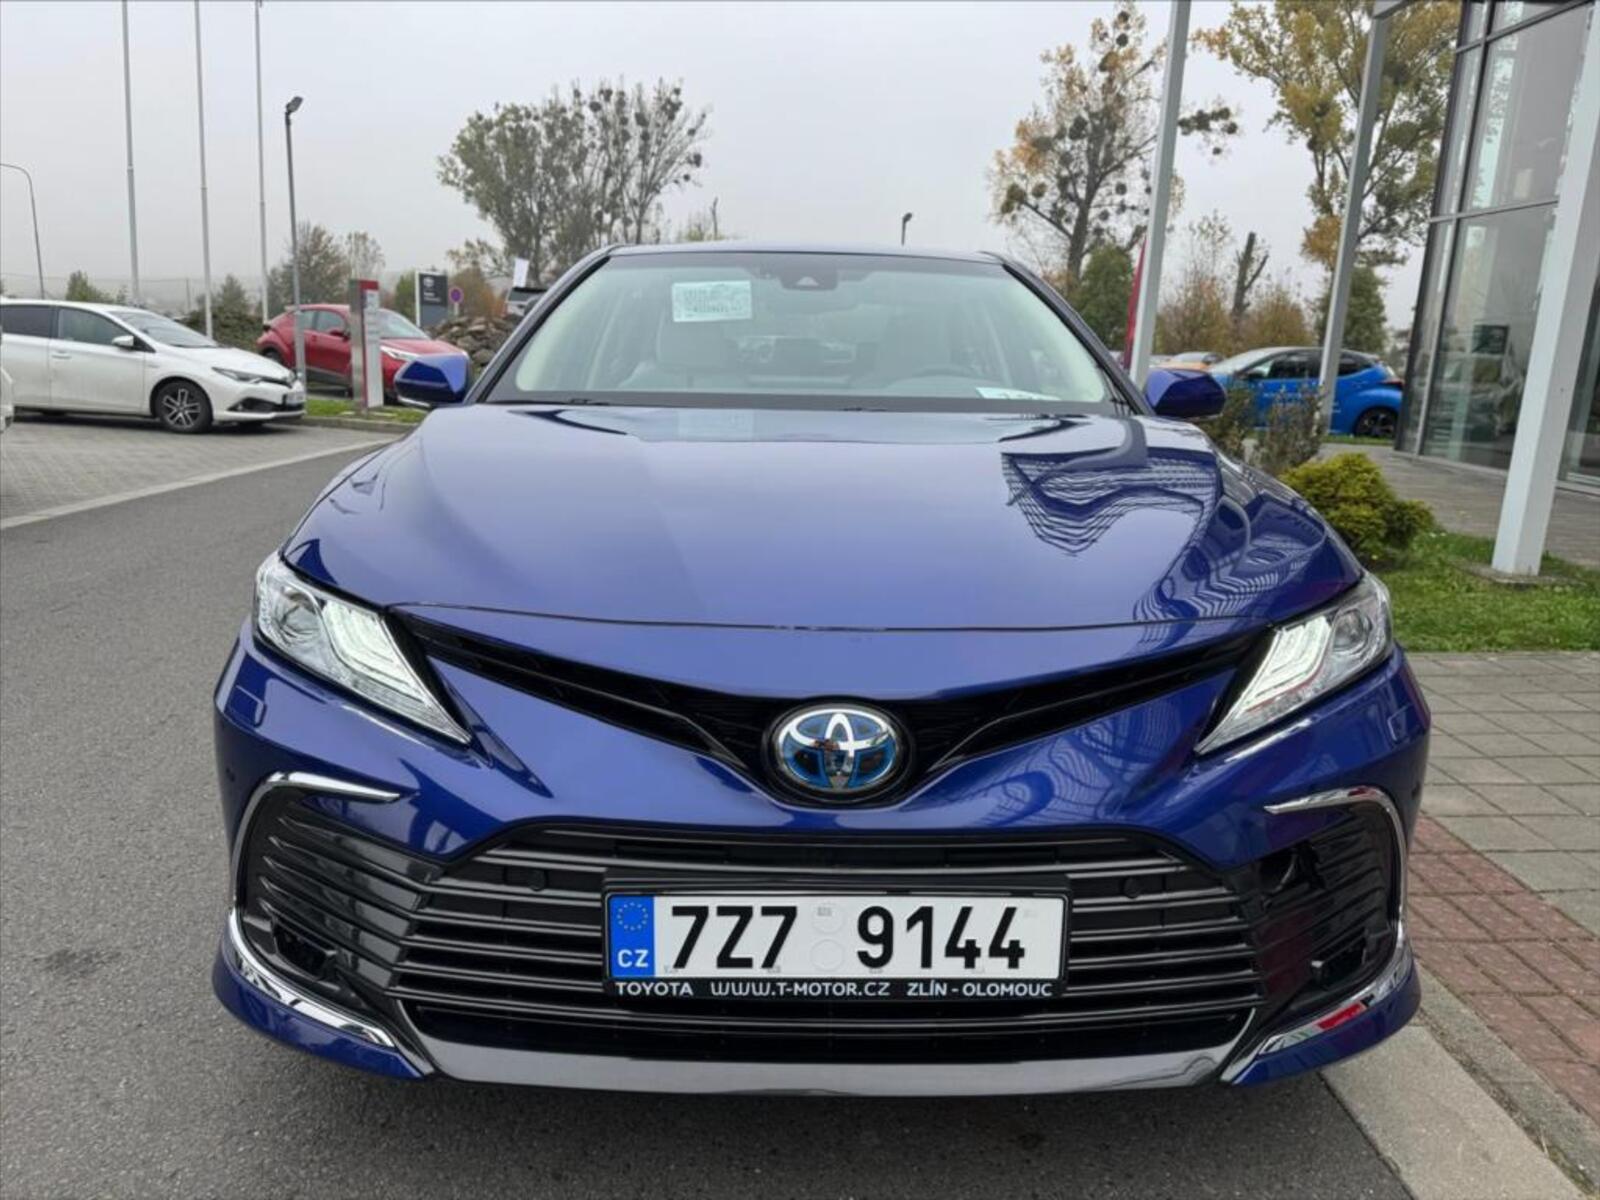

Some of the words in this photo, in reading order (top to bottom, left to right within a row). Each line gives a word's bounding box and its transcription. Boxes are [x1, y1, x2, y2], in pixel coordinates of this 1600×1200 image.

[672, 905, 797, 969] 7Z7
[857, 905, 1025, 969] 9144
[617, 949, 649, 968] CZ
[615, 982, 694, 997] TOYOTA
[710, 982, 890, 997] WWW.T-MOTOR.CZ
[907, 979, 948, 997] ZLÍN
[962, 982, 1053, 997] OLOMOUC
